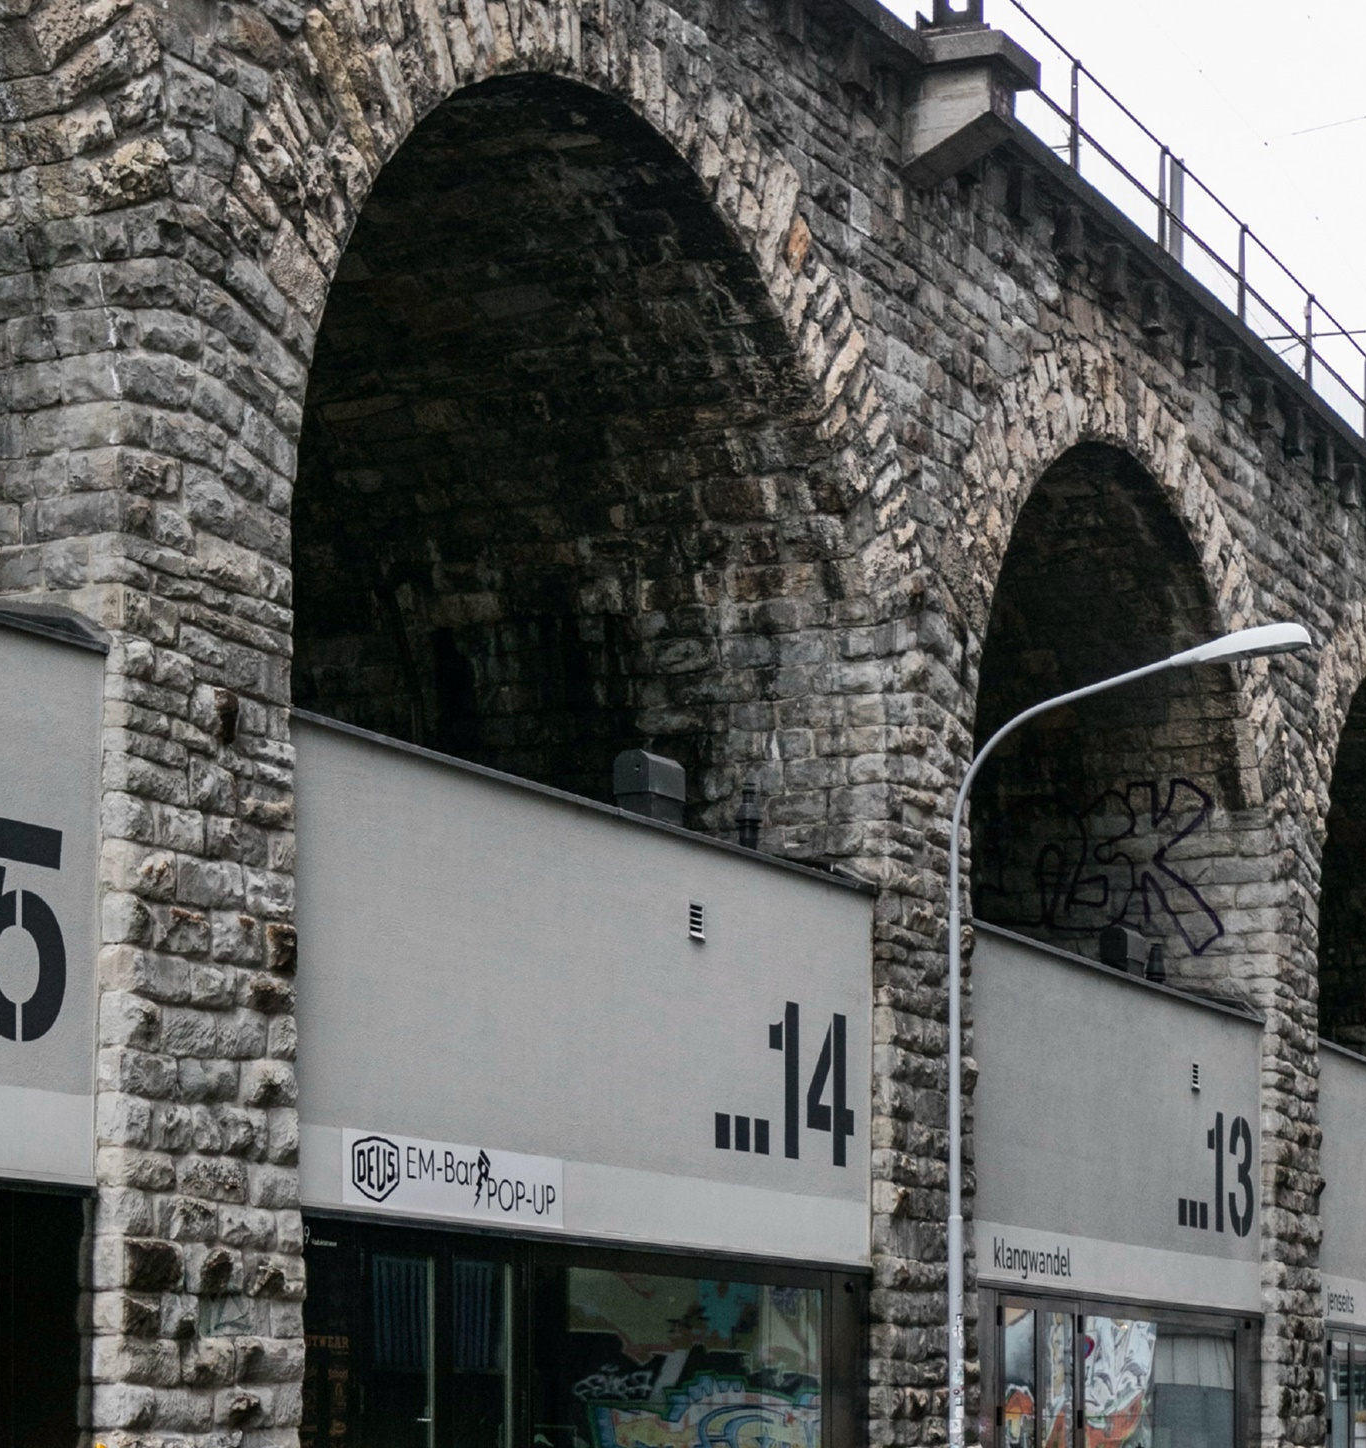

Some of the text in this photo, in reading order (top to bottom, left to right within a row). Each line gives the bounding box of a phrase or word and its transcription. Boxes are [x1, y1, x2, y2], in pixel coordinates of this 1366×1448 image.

[356, 1145, 396, 1192] DEUS
[407, 1146, 476, 1186] EM-Bar
[487, 1178, 556, 1215] POP-UP
[993, 1236, 1072, 1280] klangwandel
